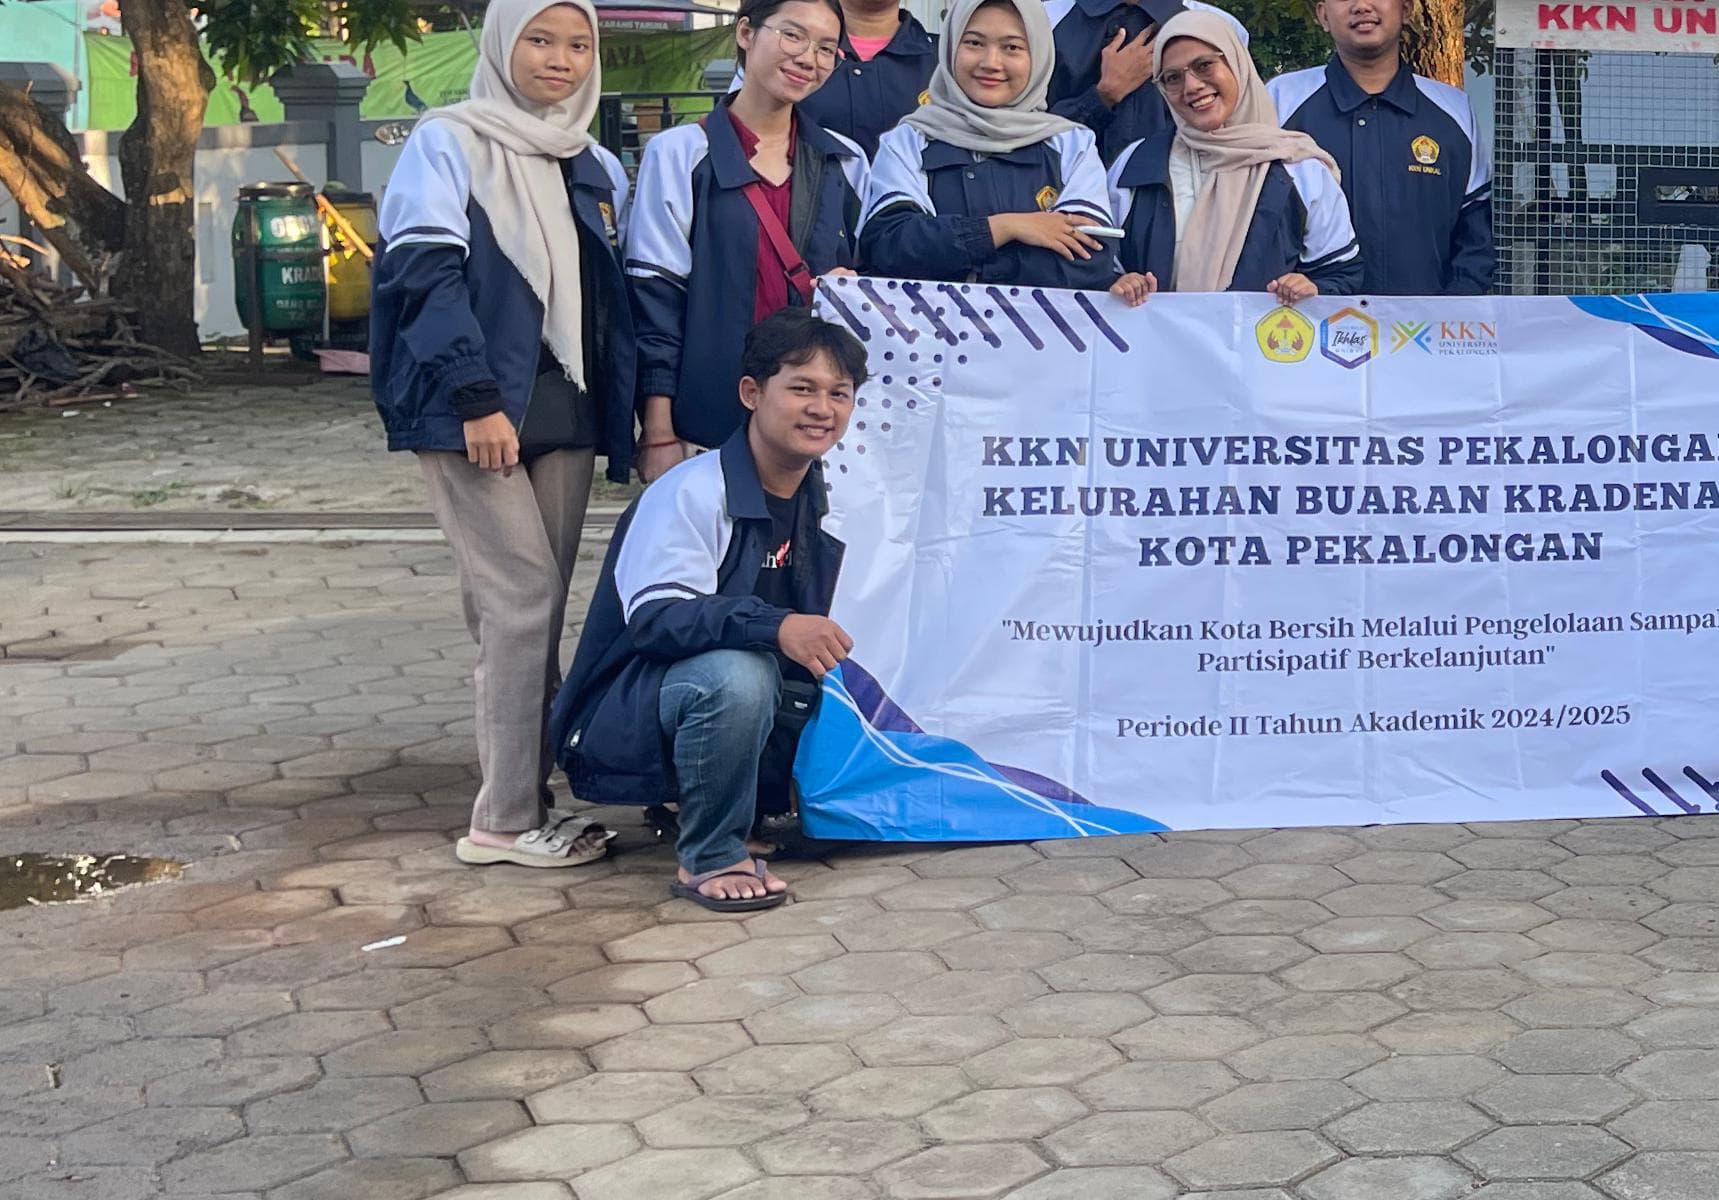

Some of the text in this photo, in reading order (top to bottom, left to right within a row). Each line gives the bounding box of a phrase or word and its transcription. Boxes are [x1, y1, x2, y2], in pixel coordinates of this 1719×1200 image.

[1537, 4, 1637, 32] KKN
[1331, 330, 1367, 346] Ikhlas
[1440, 320, 1497, 339] KKN
[981, 436, 1090, 468] KKN
[1103, 435, 1425, 468] UNIVERSITAS
[982, 485, 1282, 518] KELURAHAN
[1295, 484, 1490, 516] BUARAN
[1138, 531, 1604, 567] KOTA PEKALONGAN
[1002, 616, 1194, 648] "Mewujudkan
[1199, 616, 1262, 641] Kota
[1268, 614, 1355, 640] Bersih
[1361, 612, 1458, 638] Melalui
[1464, 610, 1624, 641] Pengelolaan
[1197, 643, 1555, 677] Partisipatif Berkelanjutan"
[1117, 704, 1631, 738] Periode II Tahun Akademik 2024/2025
